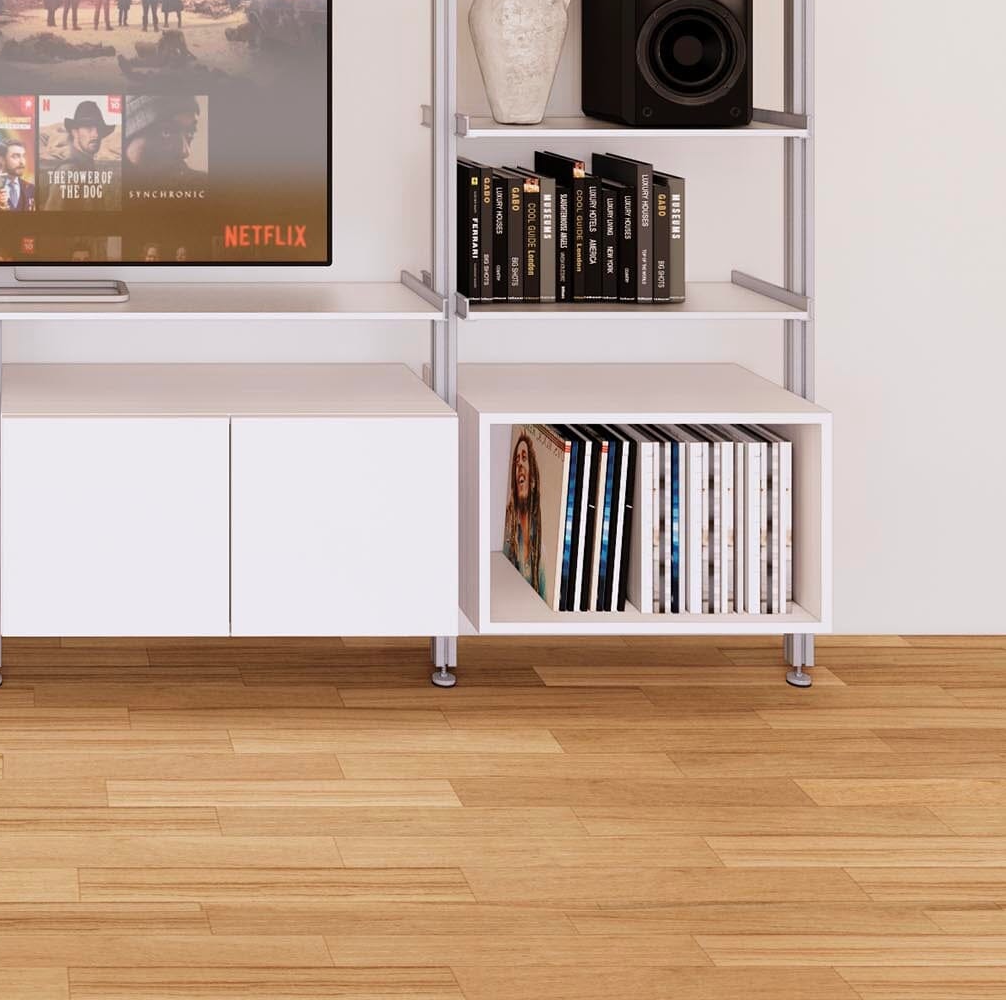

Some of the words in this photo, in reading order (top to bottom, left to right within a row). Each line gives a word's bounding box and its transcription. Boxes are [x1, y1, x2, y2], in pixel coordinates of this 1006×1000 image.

[48, 170, 66, 184] THE
[68, 170, 100, 184] POWER
[102, 170, 113, 184] OF
[60, 184, 82, 199] THE
[84, 184, 103, 199] DOG
[129, 190, 206, 199] SYNCHRONIC
[512, 187, 520, 212] GABO
[589, 186, 597, 209] LUXURY
[528, 202, 536, 223] COOL
[606, 198, 614, 218] LUXURY
[624, 196, 632, 217] LUXURY
[658, 194, 667, 217] GABO
[543, 194, 552, 239] MUSEUMS
[589, 210, 597, 232] HOTELS
[672, 194, 681, 239] MUSEUMS
[224, 224, 307, 248] NETFLIX
[528, 226, 536, 248] GUIDE
[606, 220, 614, 236] LIVING
[624, 218, 632, 240] HOUSES
[511, 256, 519, 267] BIG
[589, 238, 597, 265] AMERICA
[606, 246, 614, 258] NEW
[528, 250, 536, 276] London
[606, 259, 614, 274] YORK
[511, 268, 519, 287] SHOTS
